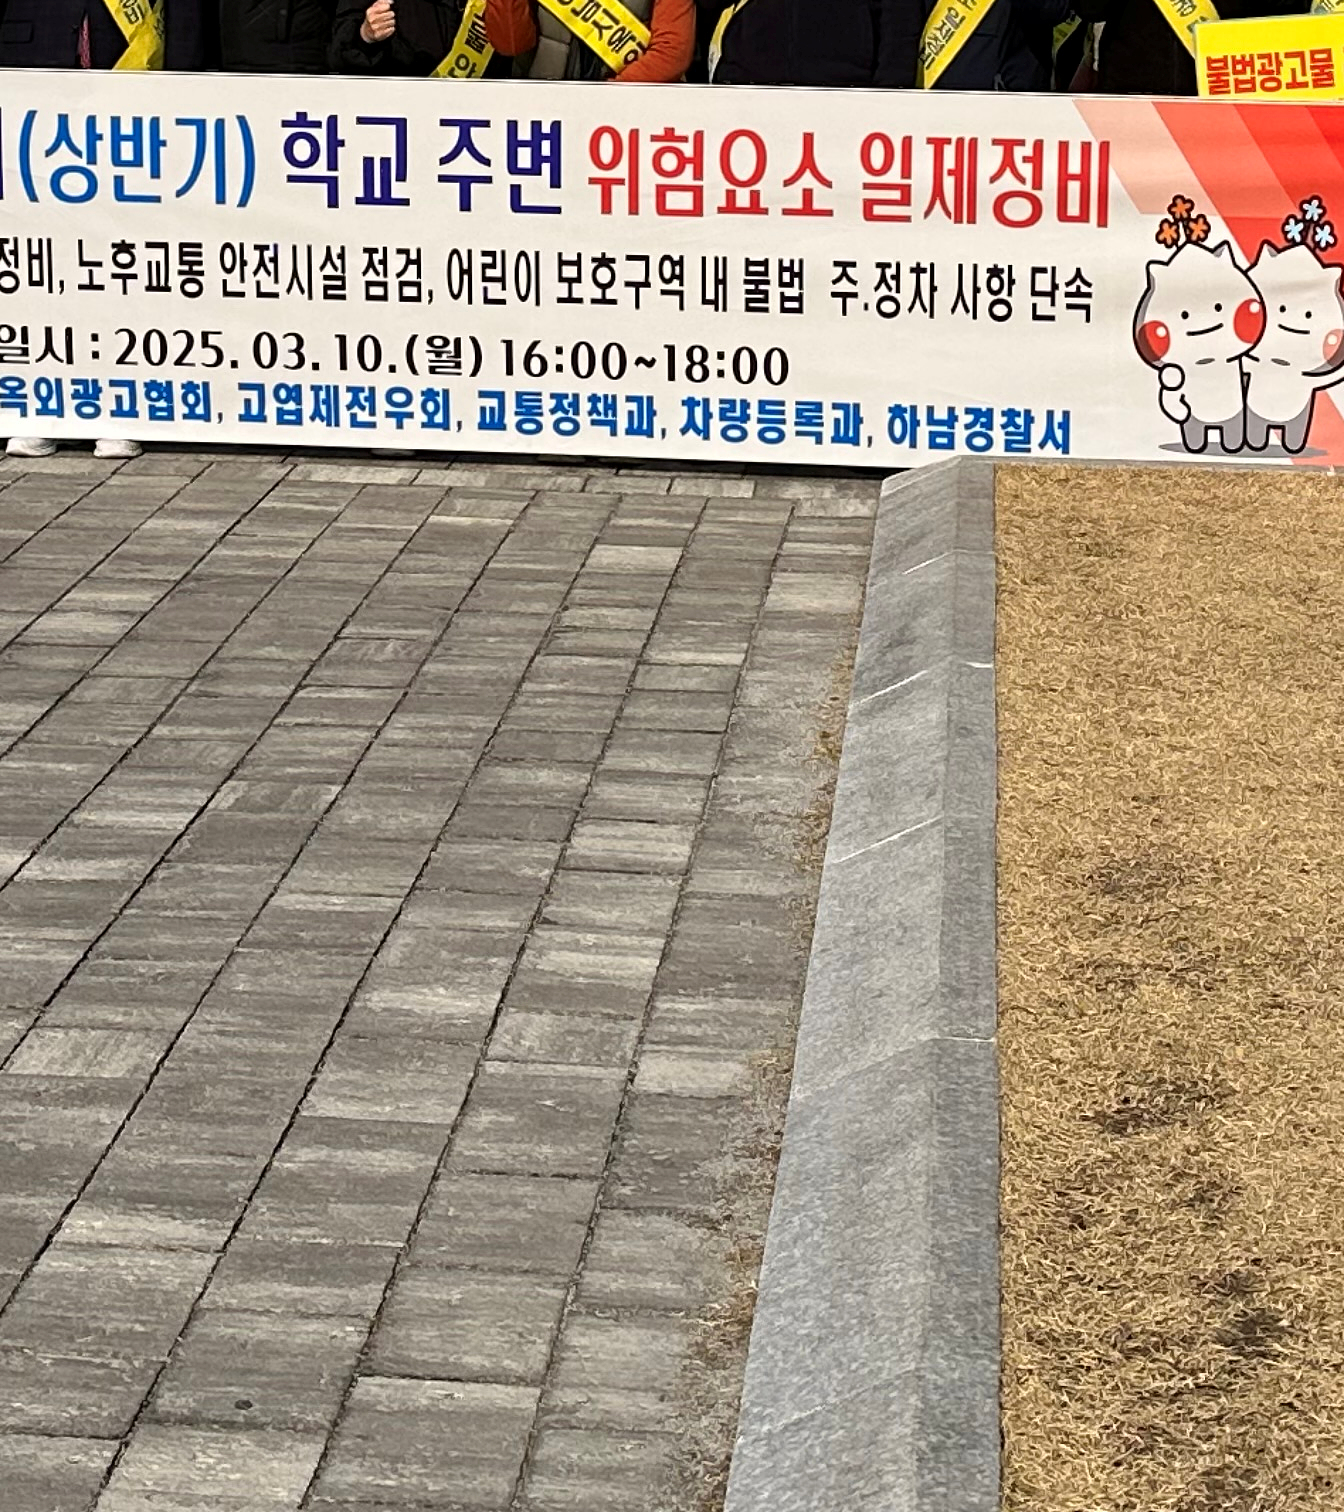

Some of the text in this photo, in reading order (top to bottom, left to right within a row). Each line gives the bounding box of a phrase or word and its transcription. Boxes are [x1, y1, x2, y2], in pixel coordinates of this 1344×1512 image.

[1206, 47, 1335, 95] 불법광고물
[282, 109, 409, 210] 학교
[436, 116, 564, 216] 주변
[586, 123, 836, 221] 위험요소
[859, 129, 1111, 229] 일제정비
[76, 237, 206, 300] 노후교통
[219, 242, 348, 302] 안전시설
[360, 247, 436, 307] 점검,
[446, 249, 542, 308] 어린이
[556, 251, 686, 313] 보호구역
[700, 254, 730, 313] 내
[742, 256, 805, 315] 불법
[829, 259, 939, 321] 주.정차
[950, 262, 1016, 322] 사항
[1029, 265, 1095, 324] 단속
[500, 338, 791, 387] 16:00~18:00
[237, 381, 463, 433] 고엽제전우회,
[476, 388, 665, 441] 교통정책과,
[679, 395, 874, 449] 차량등록과,
[886, 402, 1073, 456] 하남경찰서
